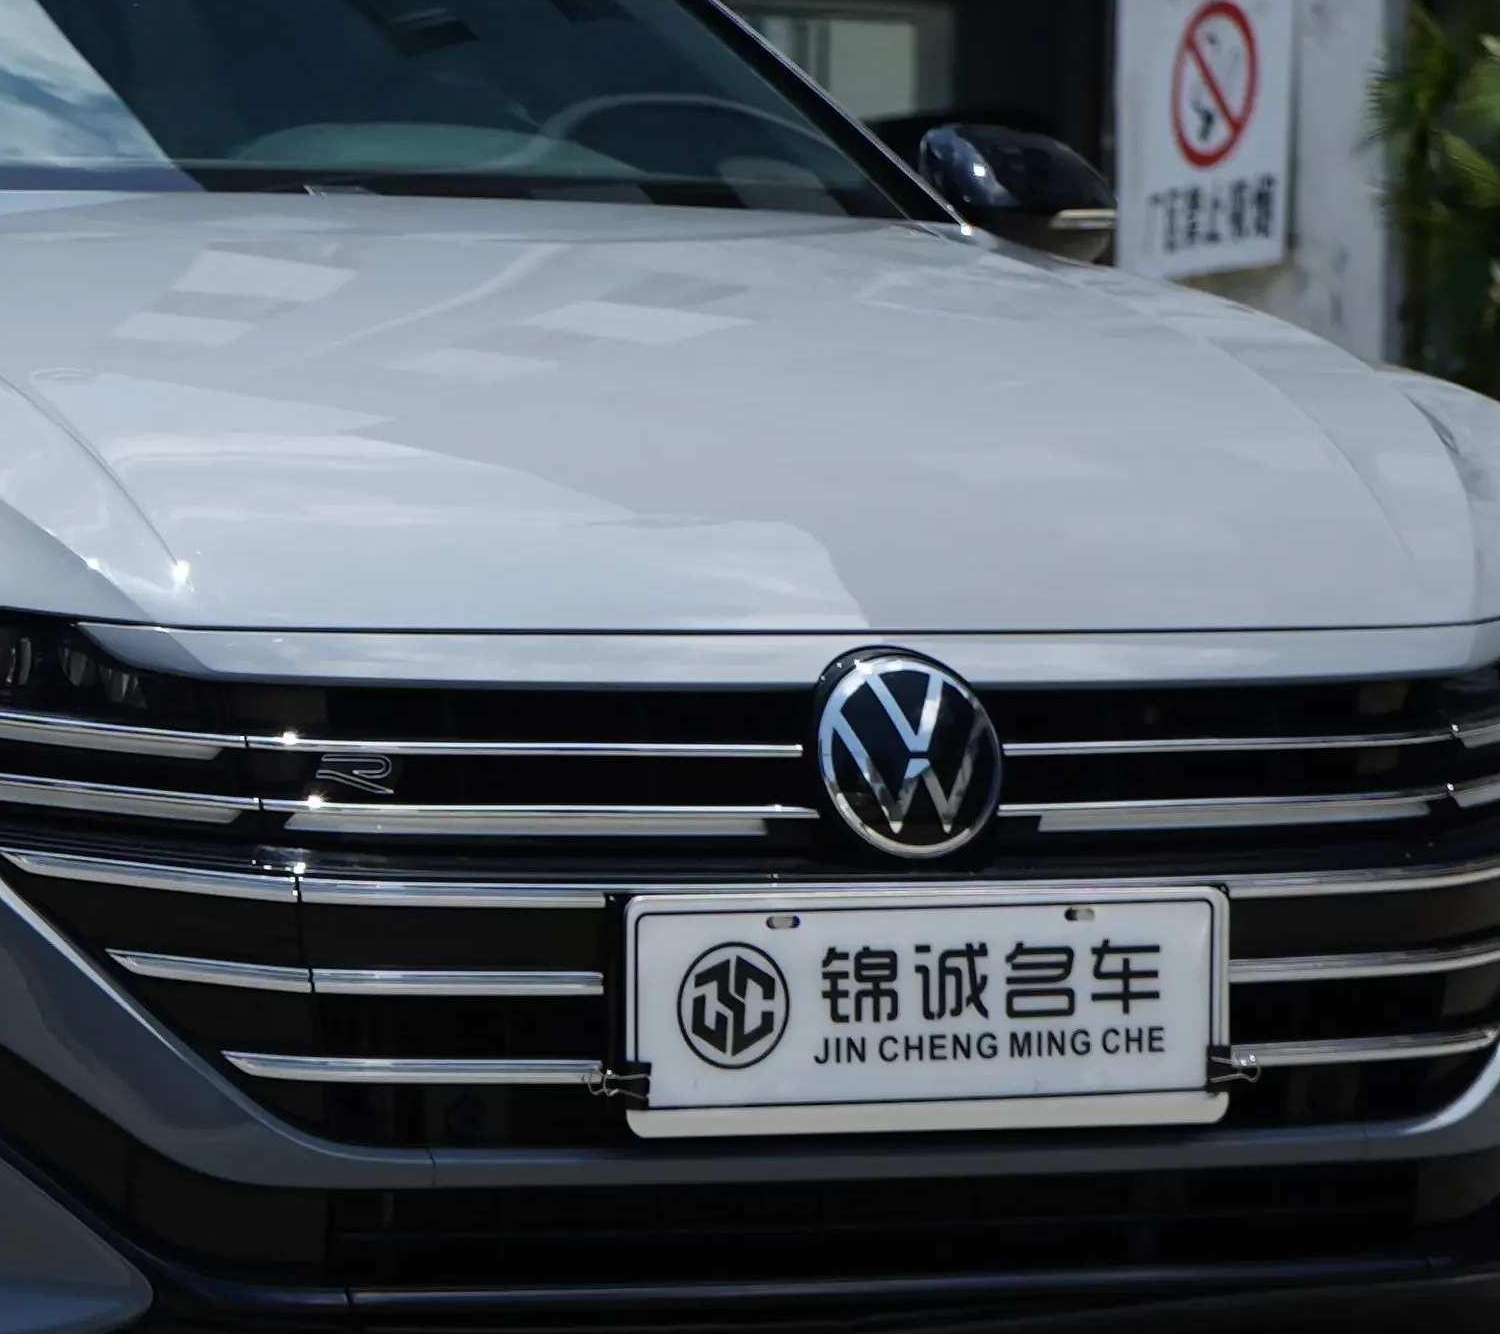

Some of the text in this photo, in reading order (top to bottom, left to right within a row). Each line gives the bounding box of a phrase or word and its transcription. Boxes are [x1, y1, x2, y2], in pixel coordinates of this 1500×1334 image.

[315, 753, 395, 794] R
[820, 939, 1161, 1024] 锦诚名车
[813, 1025, 1166, 1065] JIN CHENG MING CHE
